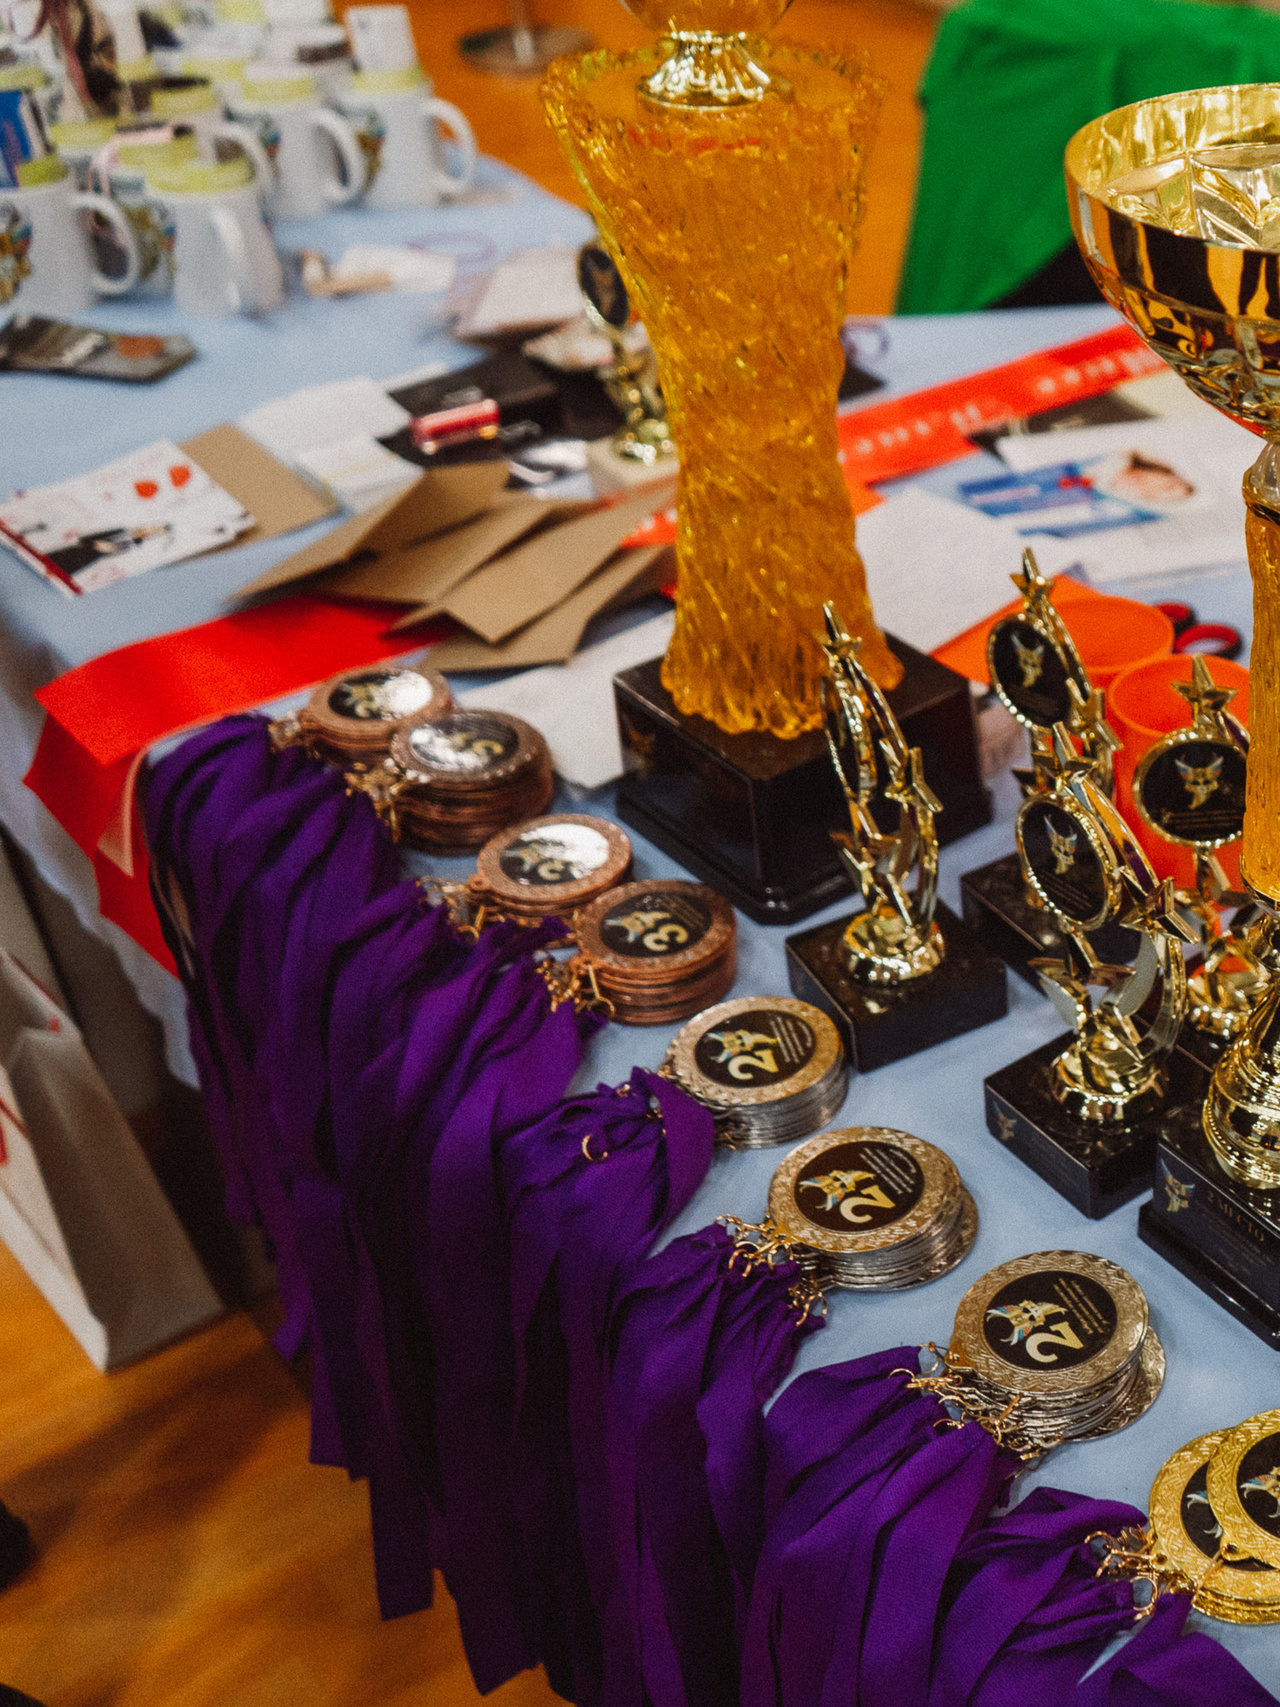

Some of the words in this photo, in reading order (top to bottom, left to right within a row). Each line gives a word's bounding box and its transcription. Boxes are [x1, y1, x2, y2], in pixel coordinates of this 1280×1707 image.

[643, 923, 689, 952] 3
[728, 1049, 780, 1081] 2
[839, 1184, 896, 1224] 2
[1025, 1320, 1084, 1363] 2
